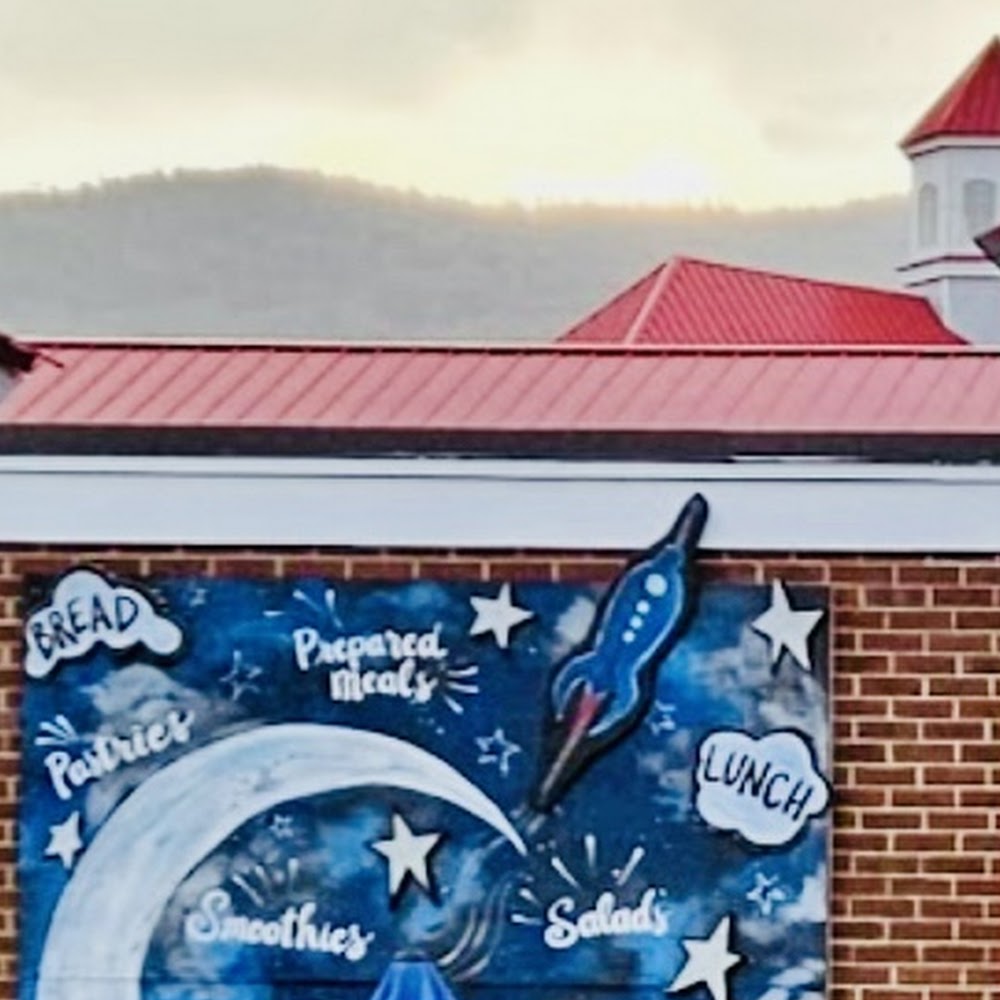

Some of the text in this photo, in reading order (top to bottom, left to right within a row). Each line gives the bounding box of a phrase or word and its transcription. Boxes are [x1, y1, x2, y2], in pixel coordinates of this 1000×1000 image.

[30, 594, 140, 660] BREAD
[293, 622, 447, 670] Prepared
[44, 709, 195, 800] Pastries
[702, 743, 814, 821] LUNCH
[184, 889, 375, 961] Smoothies
[543, 888, 669, 949] Salads
